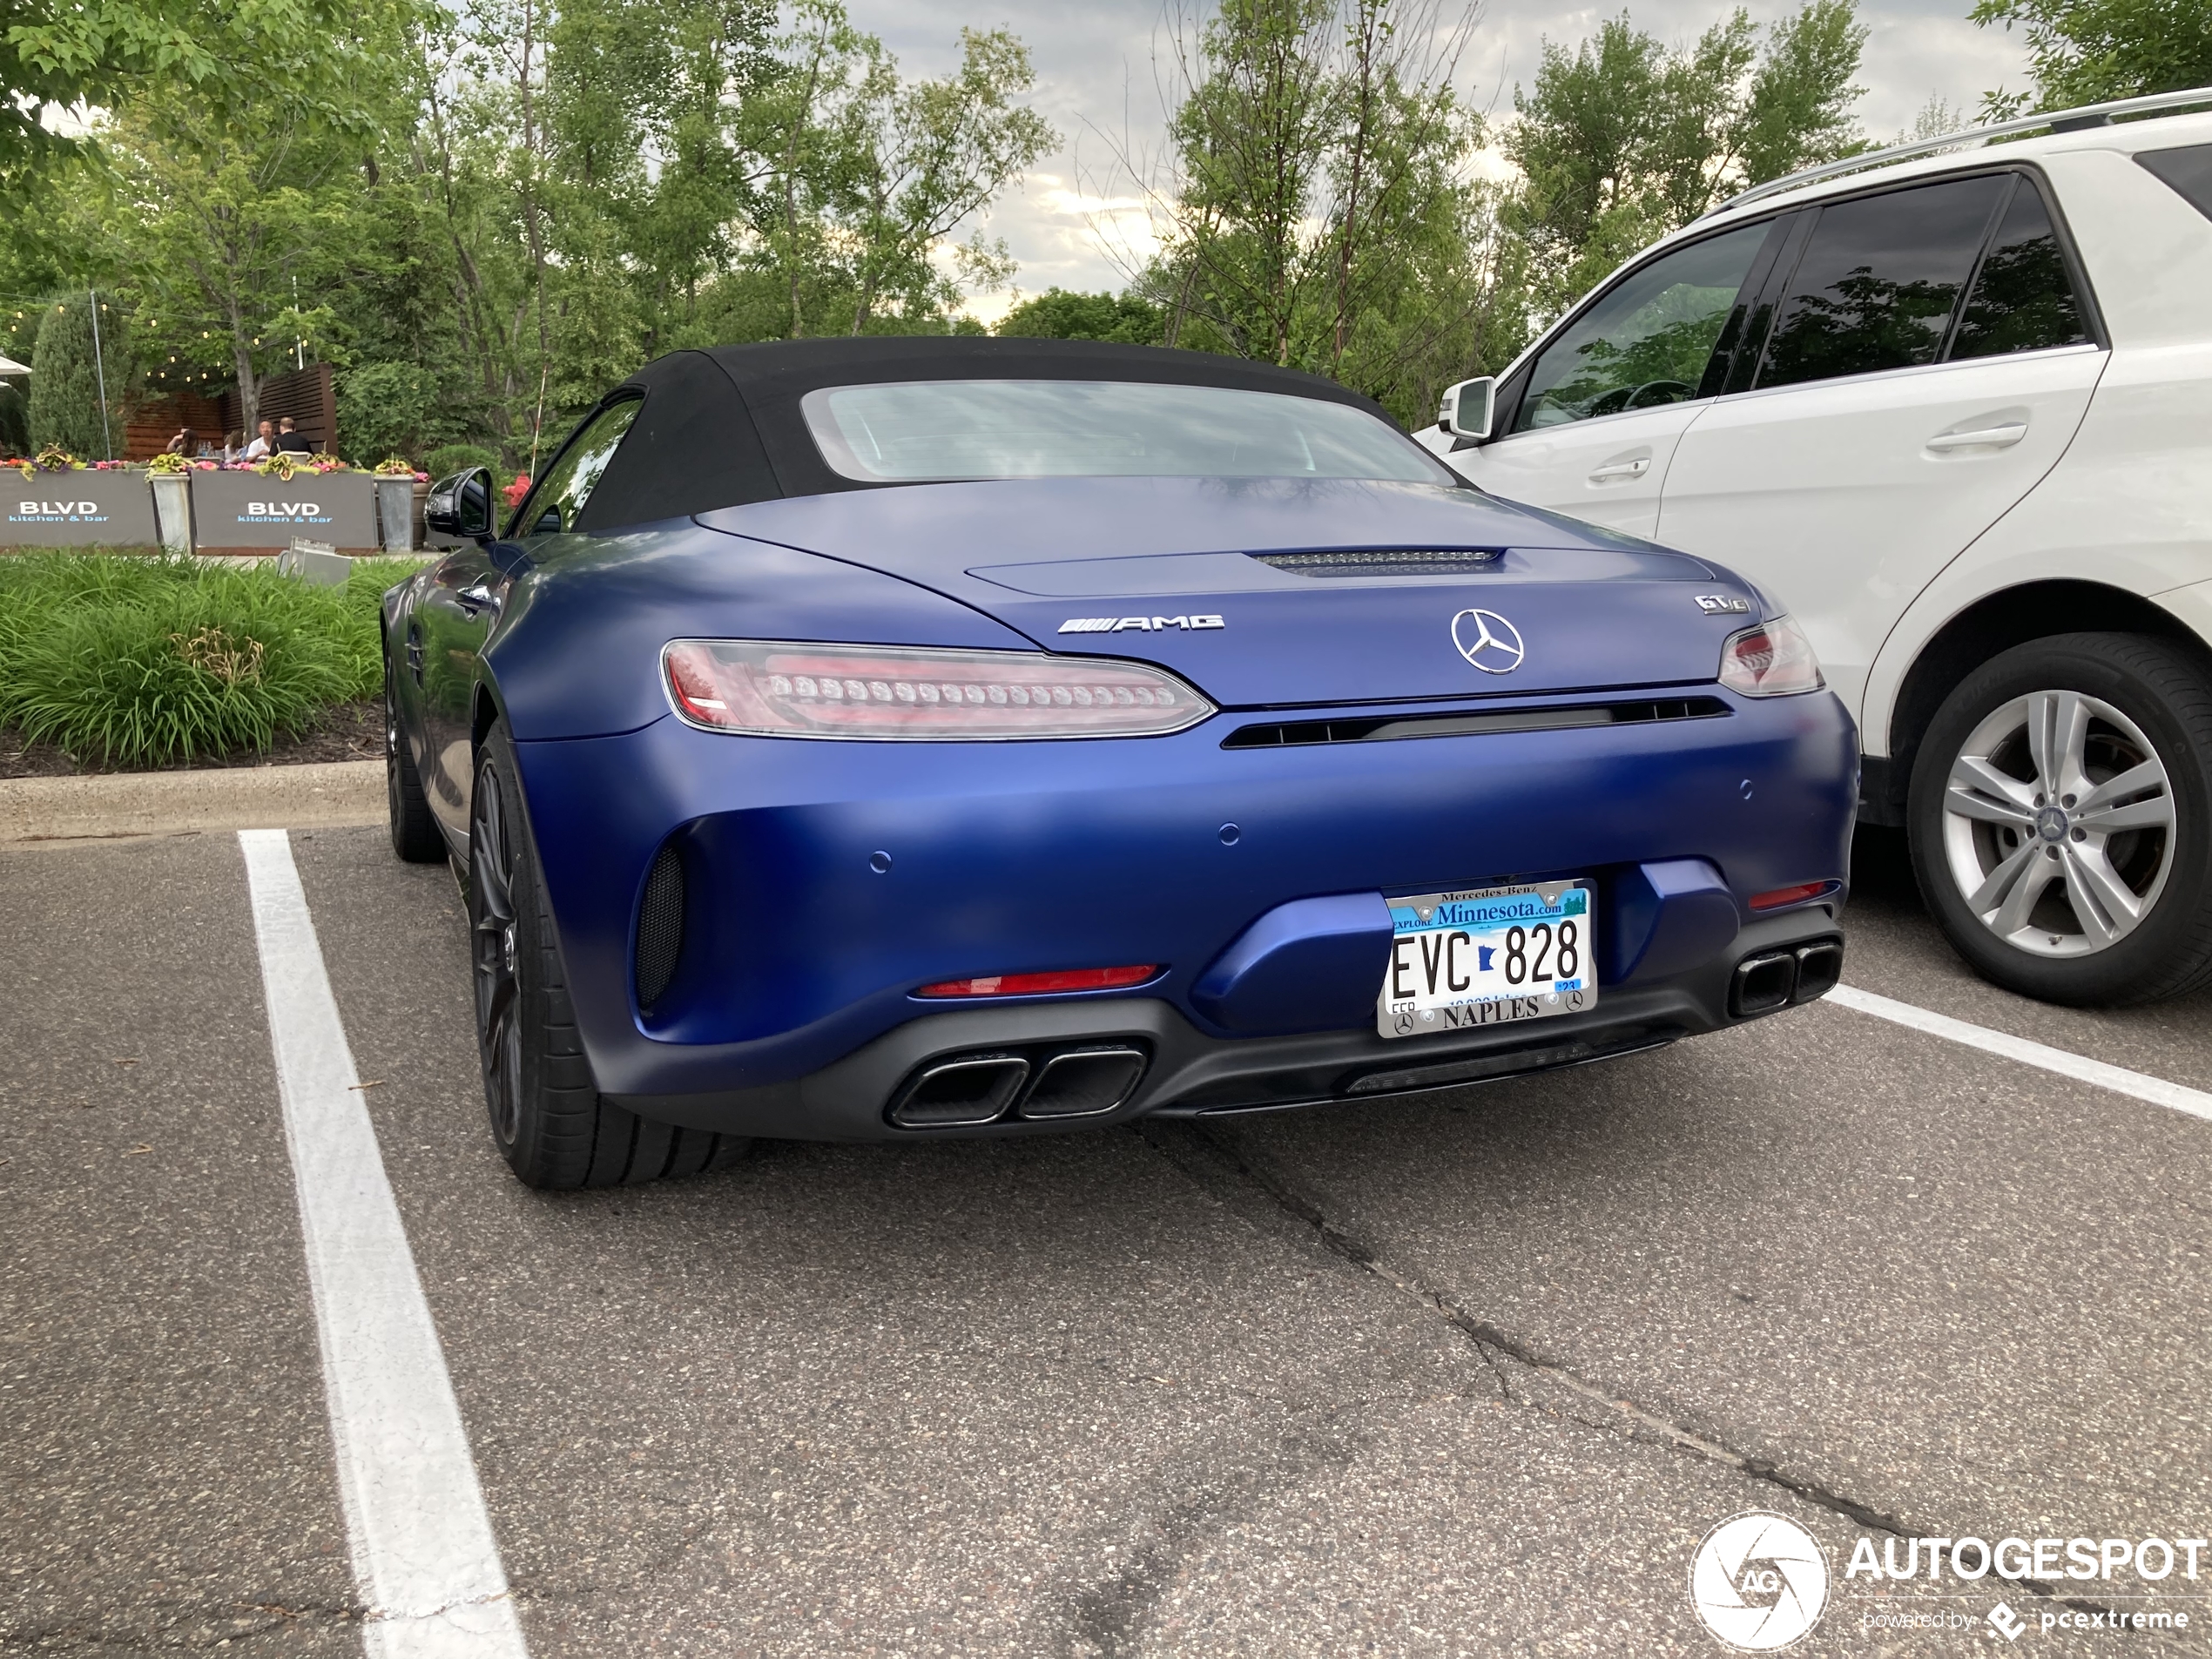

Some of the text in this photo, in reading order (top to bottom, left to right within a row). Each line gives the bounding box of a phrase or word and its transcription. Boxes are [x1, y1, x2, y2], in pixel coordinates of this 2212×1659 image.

[19, 501, 98, 515] BLVD
[247, 502, 320, 516] BLVD
[237, 515, 290, 523] kitchen
[1112, 615, 1225, 633] AMG
[1441, 886, 1538, 902] Mercedes-Benz
[1393, 901, 1562, 930] EXPLORE Minnesota.com
[1393, 920, 1579, 1000] EVC 828
[1442, 995, 1541, 1029] NAPLES
